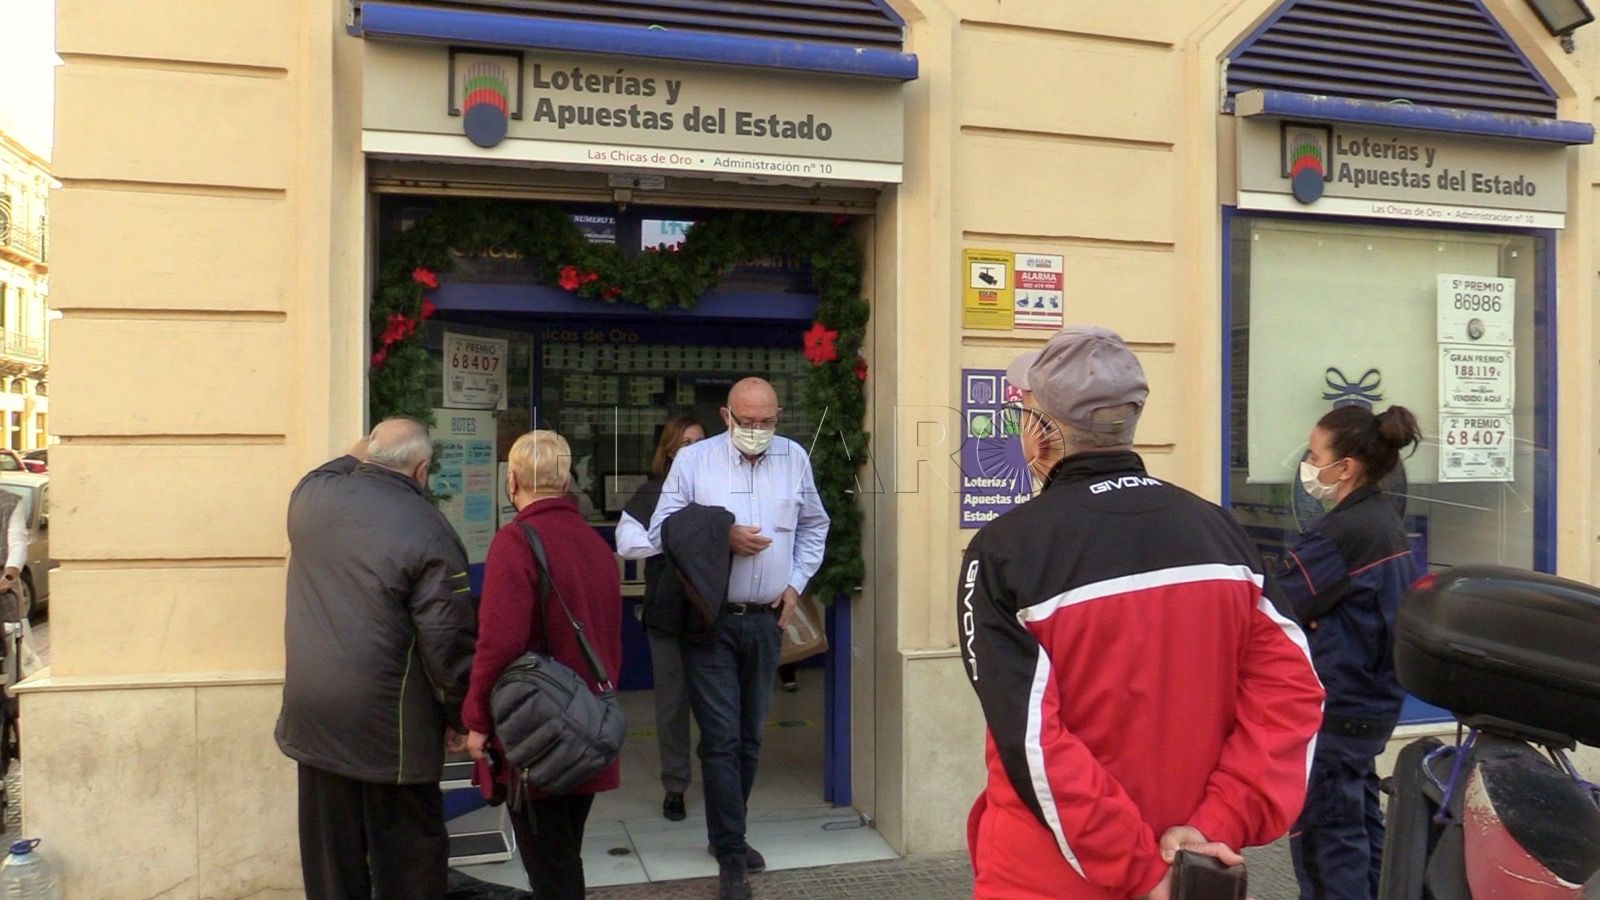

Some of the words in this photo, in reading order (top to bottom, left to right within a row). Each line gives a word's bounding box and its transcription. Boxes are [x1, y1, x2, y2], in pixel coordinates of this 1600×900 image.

[533, 64, 657, 97] Loterías
[666, 79, 682, 105] y
[533, 98, 674, 130] Apuestas
[682, 106, 726, 134] del
[735, 111, 833, 142] Estado
[587, 149, 607, 160] Las
[610, 150, 648, 163] Chicas
[651, 152, 666, 164] de
[669, 153, 692, 165] Oro
[1336, 134, 1419, 161] Loterías
[1425, 147, 1436, 168] y
[713, 156, 800, 173] Administración
[820, 163, 833, 174] 10
[1337, 162, 1431, 189] Apuestas
[1437, 169, 1466, 192] del
[1471, 173, 1537, 197] Estado
[1371, 204, 1385, 214] Las
[1387, 205, 1412, 216] Chicas
[1414, 206, 1424, 216] de
[1426, 207, 1442, 218] Oro
[1455, 210, 1513, 222] Administración
[1525, 214, 1535, 224] 10
[1021, 271, 1057, 281] ALARMA
[1464, 280, 1505, 292] PREMIO
[1454, 293, 1502, 313] 86986
[465, 342, 496, 355] PREMIO
[452, 352, 500, 372] 68407
[1450, 353, 1473, 363] GRAN
[1475, 354, 1504, 363] PREMIO
[451, 417, 477, 433] BOTES
[1464, 418, 1501, 429] PREMIO
[1446, 430, 1505, 446] 68407
[1089, 476, 1163, 494] GIVOVA
[964, 494, 1012, 507] Apuestas
